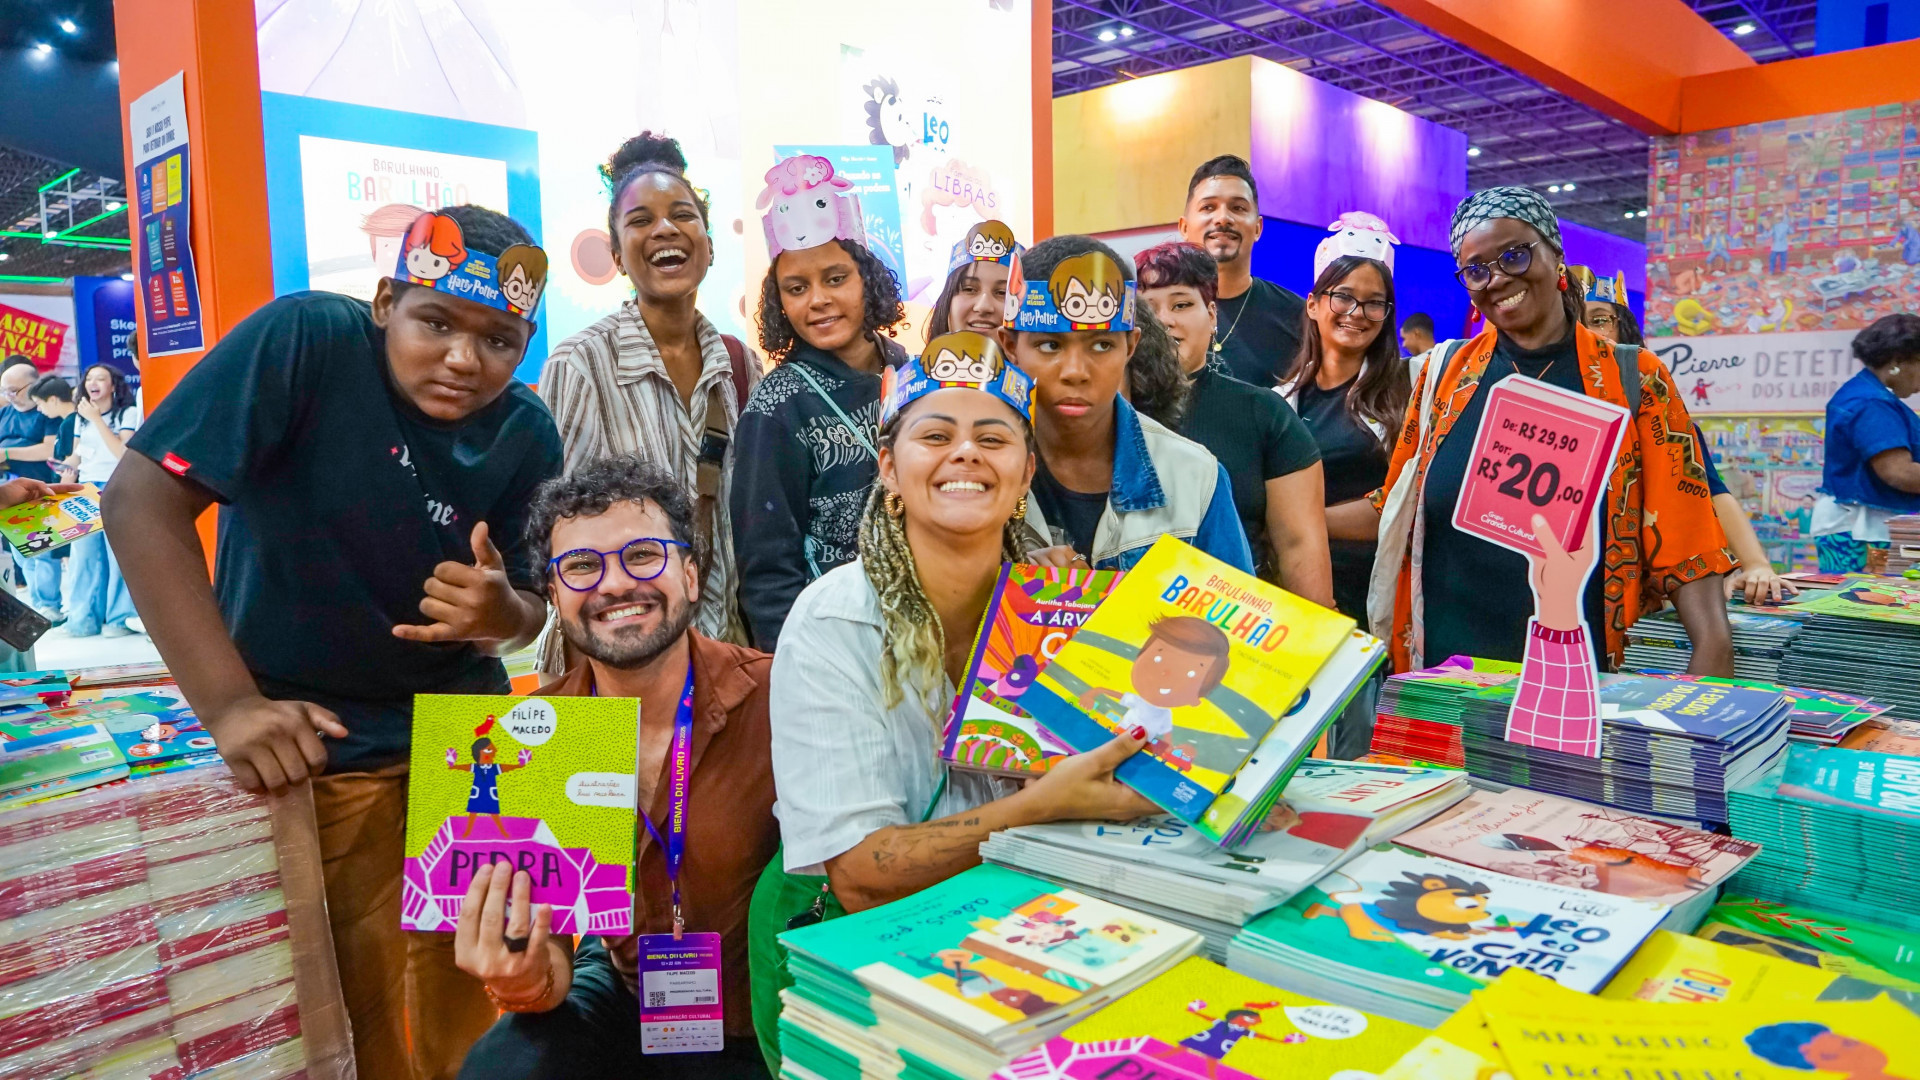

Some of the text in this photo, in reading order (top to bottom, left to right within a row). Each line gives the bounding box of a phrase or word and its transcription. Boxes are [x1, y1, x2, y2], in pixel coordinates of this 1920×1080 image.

[933, 171, 996, 209] LIBRAS
[471, 279, 500, 301] Potter
[110, 319, 137, 330] Ske
[1035, 309, 1059, 328] Potter
[1654, 343, 1854, 378] Pierre DETETI
[1751, 382, 1784, 399] DOS
[1502, 418, 1579, 453] De: R$ 29,90
[1476, 457, 1502, 484] R$
[1480, 514, 1537, 541] Ciranda Cultural
[1030, 608, 1088, 627] A ÁRV
[1160, 574, 1289, 653] BARULHÃO
[1041, 632, 1068, 660] C
[512, 707, 546, 721] FILIPE
[511, 725, 551, 735] MACEDO
[673, 799, 683, 834] BIENAL
